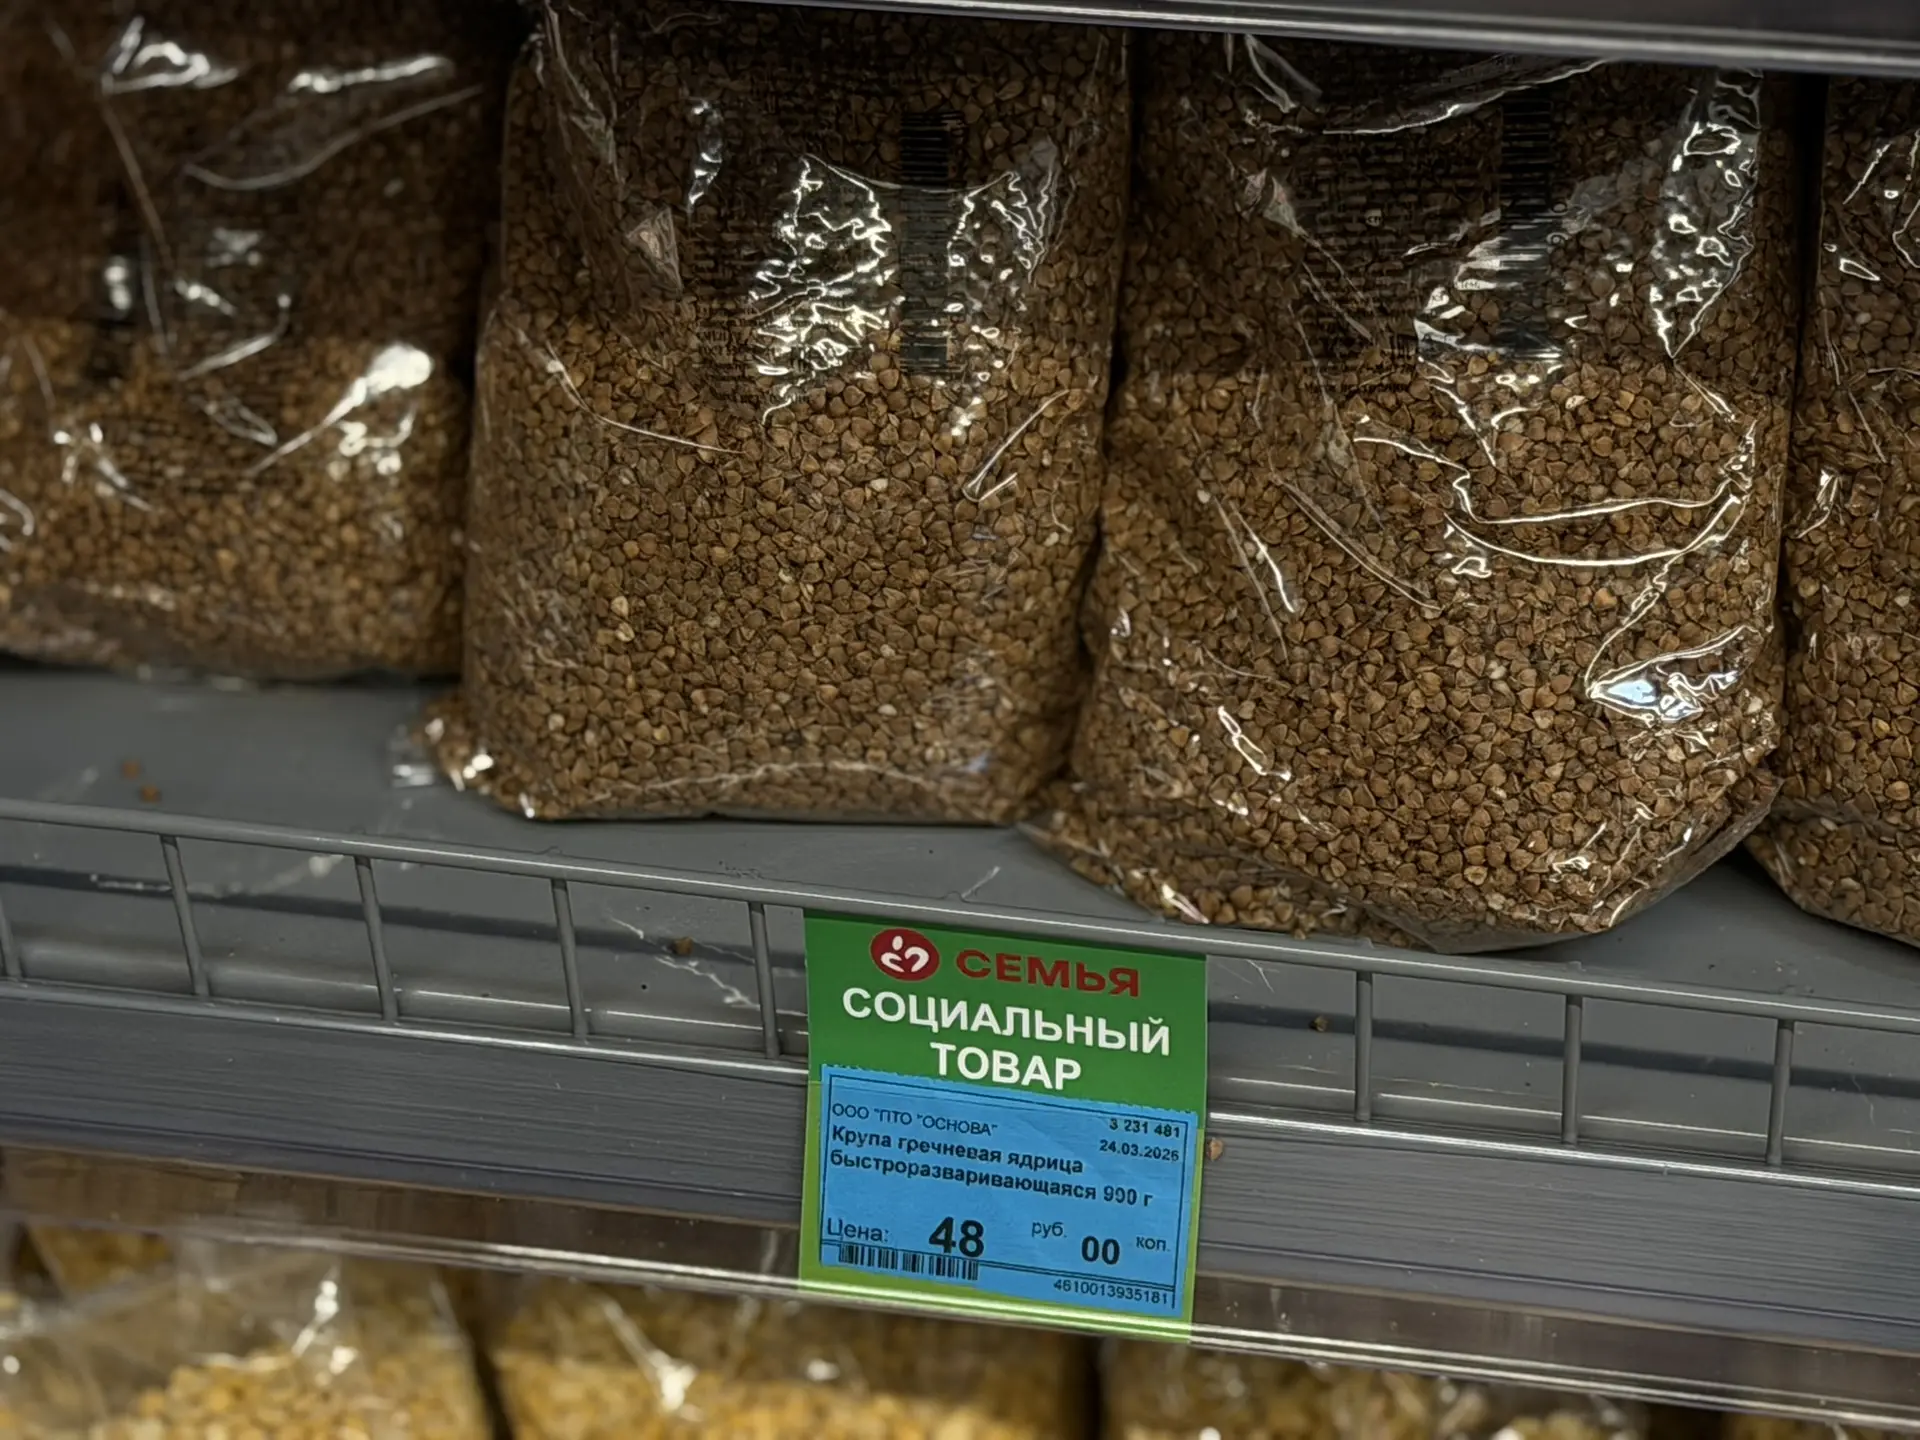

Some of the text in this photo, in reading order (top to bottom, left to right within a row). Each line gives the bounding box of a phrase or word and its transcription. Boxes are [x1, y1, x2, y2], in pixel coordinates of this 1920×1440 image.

[956, 949, 1140, 998] СЕМЬЯ
[842, 987, 1171, 1056] СОЦИАЛЬНЫЙ
[929, 1041, 1082, 1090] ТОВАР
[832, 1103, 869, 1119] ООО
[917, 1113, 998, 1136] "ОСНОВА"
[1124, 1119, 1148, 1134] 231
[1154, 1124, 1180, 1138] 481
[832, 1124, 1083, 1175] Крупа гречневая ядрица
[1099, 1138, 1179, 1162] 24.03.2026
[830, 1148, 1096, 1200] быстроразваривающаяся
[1144, 1193, 1153, 1206] г
[827, 1216, 1171, 1265] Цена: 48 руб. 00 коп.
[1053, 1278, 1167, 1304] 4610013935181
